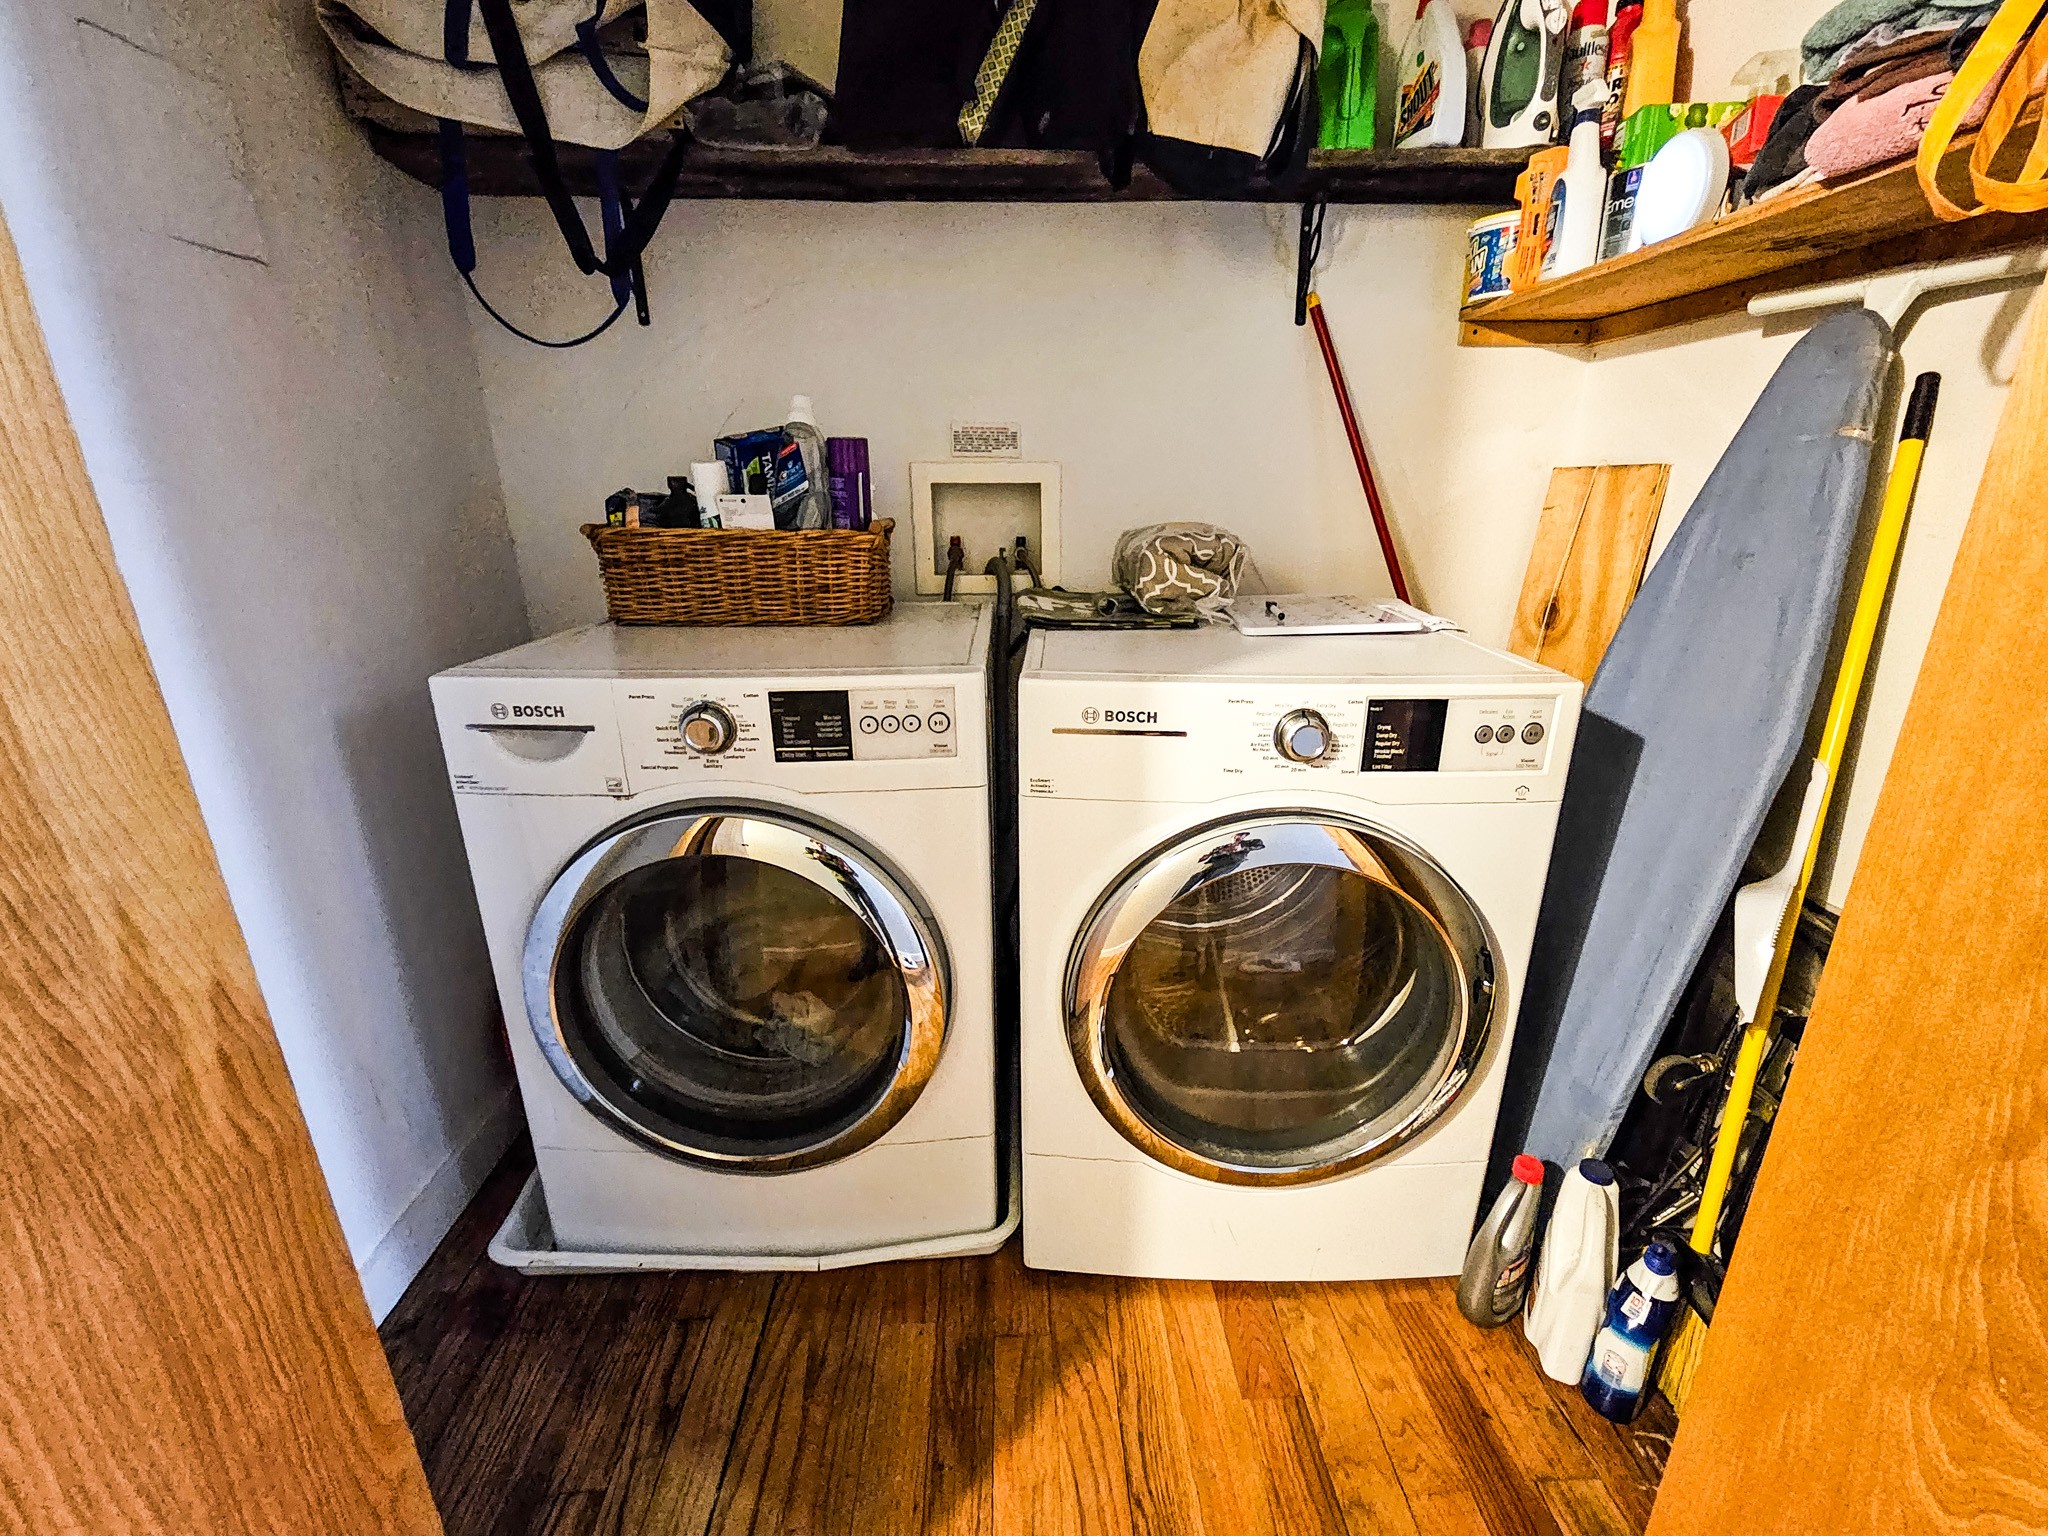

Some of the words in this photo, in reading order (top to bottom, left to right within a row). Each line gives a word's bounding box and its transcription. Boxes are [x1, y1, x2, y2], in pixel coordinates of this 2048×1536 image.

[1399, 60, 1435, 125] SHOUT
[512, 705, 565, 718] BOSCH
[1105, 710, 1158, 724] BOSCH
